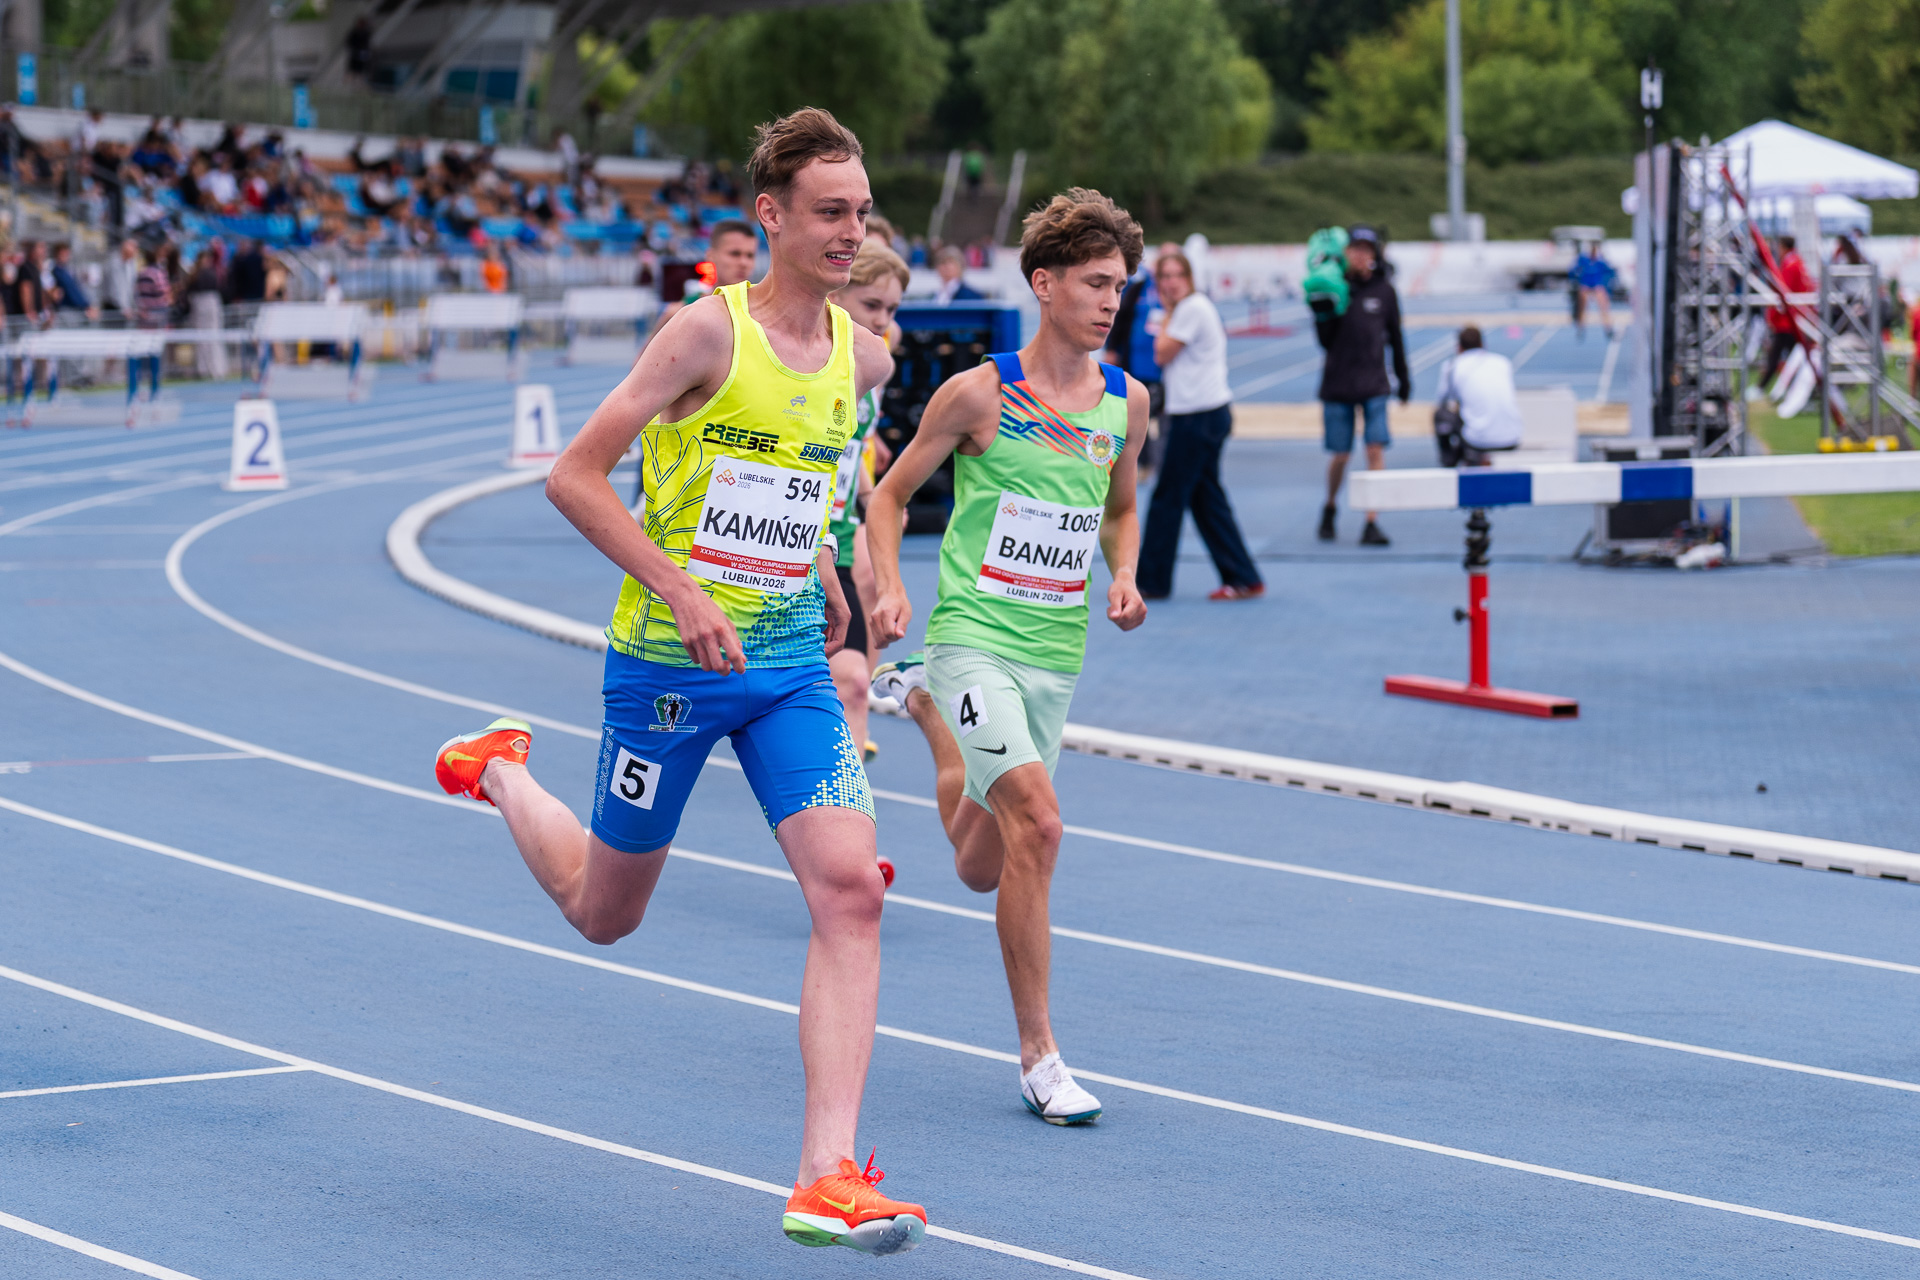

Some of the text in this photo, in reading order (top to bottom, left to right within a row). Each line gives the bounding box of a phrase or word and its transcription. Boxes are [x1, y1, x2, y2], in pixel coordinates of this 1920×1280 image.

[526, 406, 544, 445] 1
[244, 421, 270, 467] 2
[739, 472, 776, 486] LUBELSKIE
[784, 477, 821, 503] 594
[1020, 506, 1054, 519] LUBELSKIE
[1058, 512, 1100, 532] 1005
[702, 506, 818, 550] KAMIŃSKI
[700, 548, 716, 557] XXXII
[716, 552, 761, 566] OGÓLNOPOLSKA
[762, 561, 787, 569] OLIMPIADA
[998, 535, 1088, 570] BANIAK
[722, 570, 786, 589] LUBLIN 2026
[738, 563, 766, 575] SPORTACH
[766, 568, 786, 576] LETNICH
[1006, 586, 1065, 603] LUBLIN 2026
[960, 692, 979, 727] 4
[620, 757, 649, 801] 5
